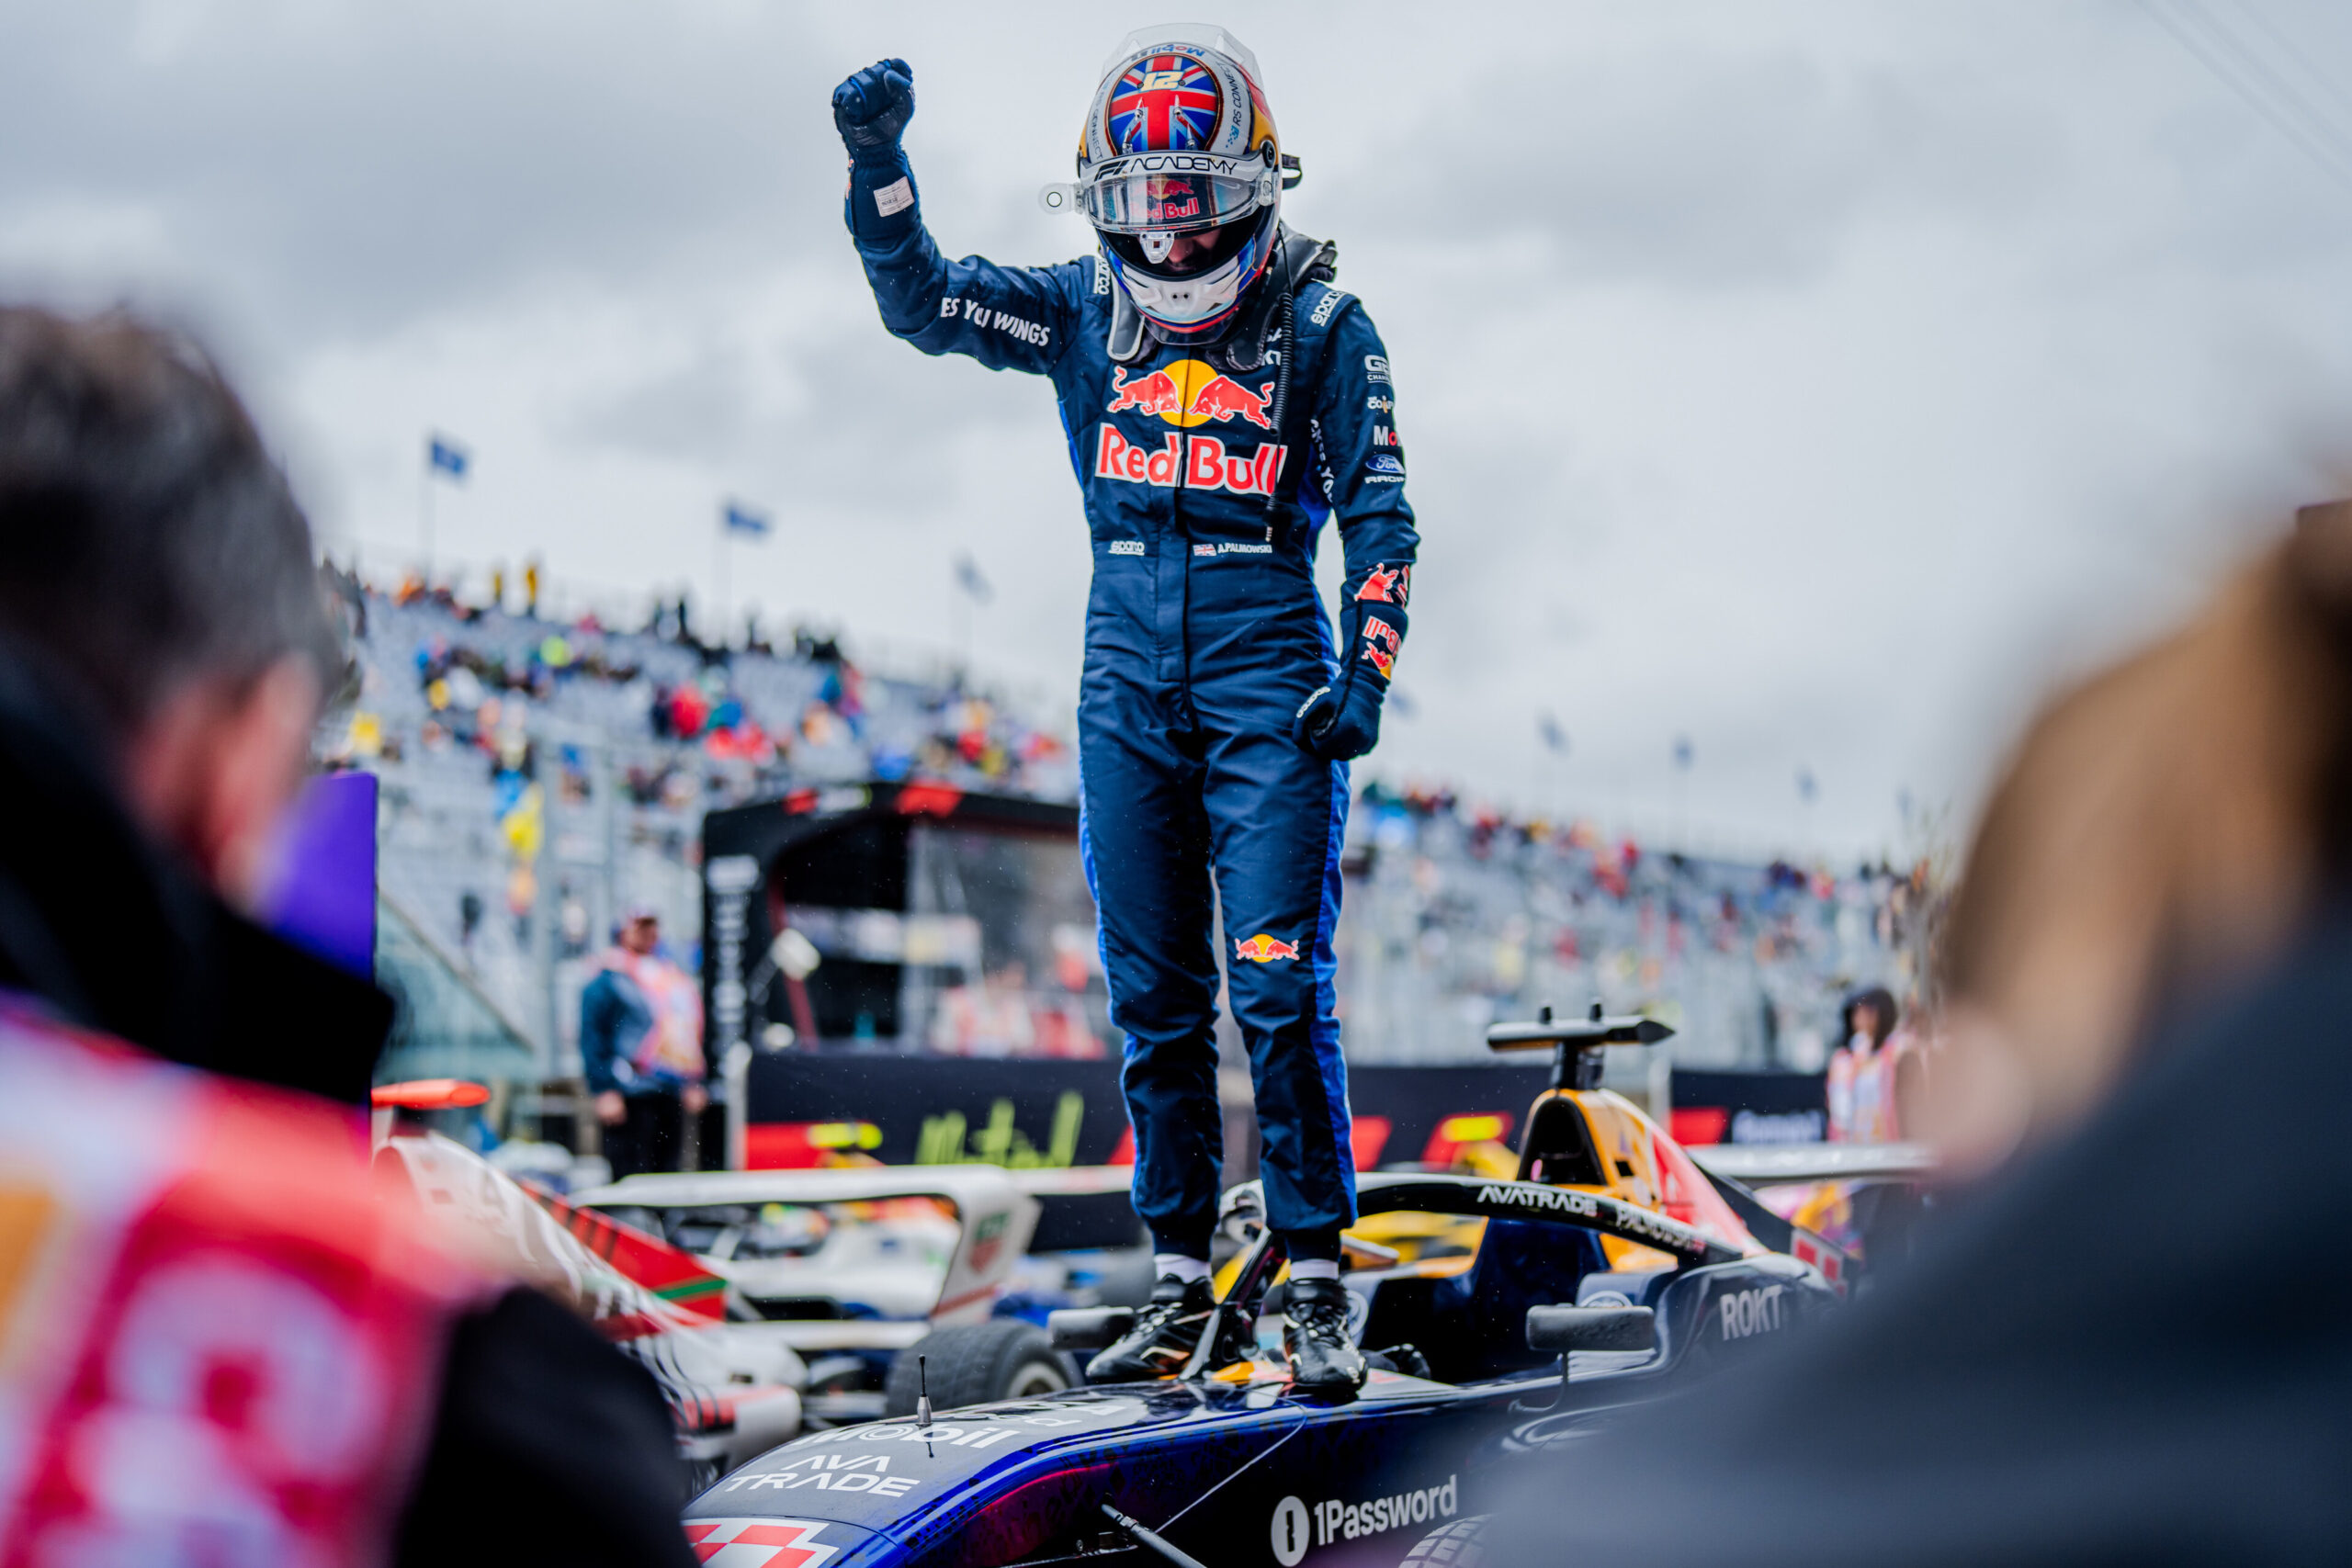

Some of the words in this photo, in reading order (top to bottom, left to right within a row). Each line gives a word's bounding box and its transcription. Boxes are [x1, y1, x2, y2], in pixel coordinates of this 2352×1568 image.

[1094, 159, 1130, 182] F1
[1130, 155, 1238, 175] ACADEMY
[1163, 197, 1200, 220] Bull
[993, 310, 1051, 347] WINGS
[1095, 422, 1184, 488] Red
[1184, 434, 1288, 497] Bull
[1476, 1184, 1599, 1218] AVATRADE
[1719, 1283, 1783, 1341] ROKT
[789, 1423, 1022, 1450] Mobil
[780, 1454, 891, 1473] AVA
[724, 1472, 921, 1498] TRADE
[1313, 1474, 1458, 1547] 1Password
